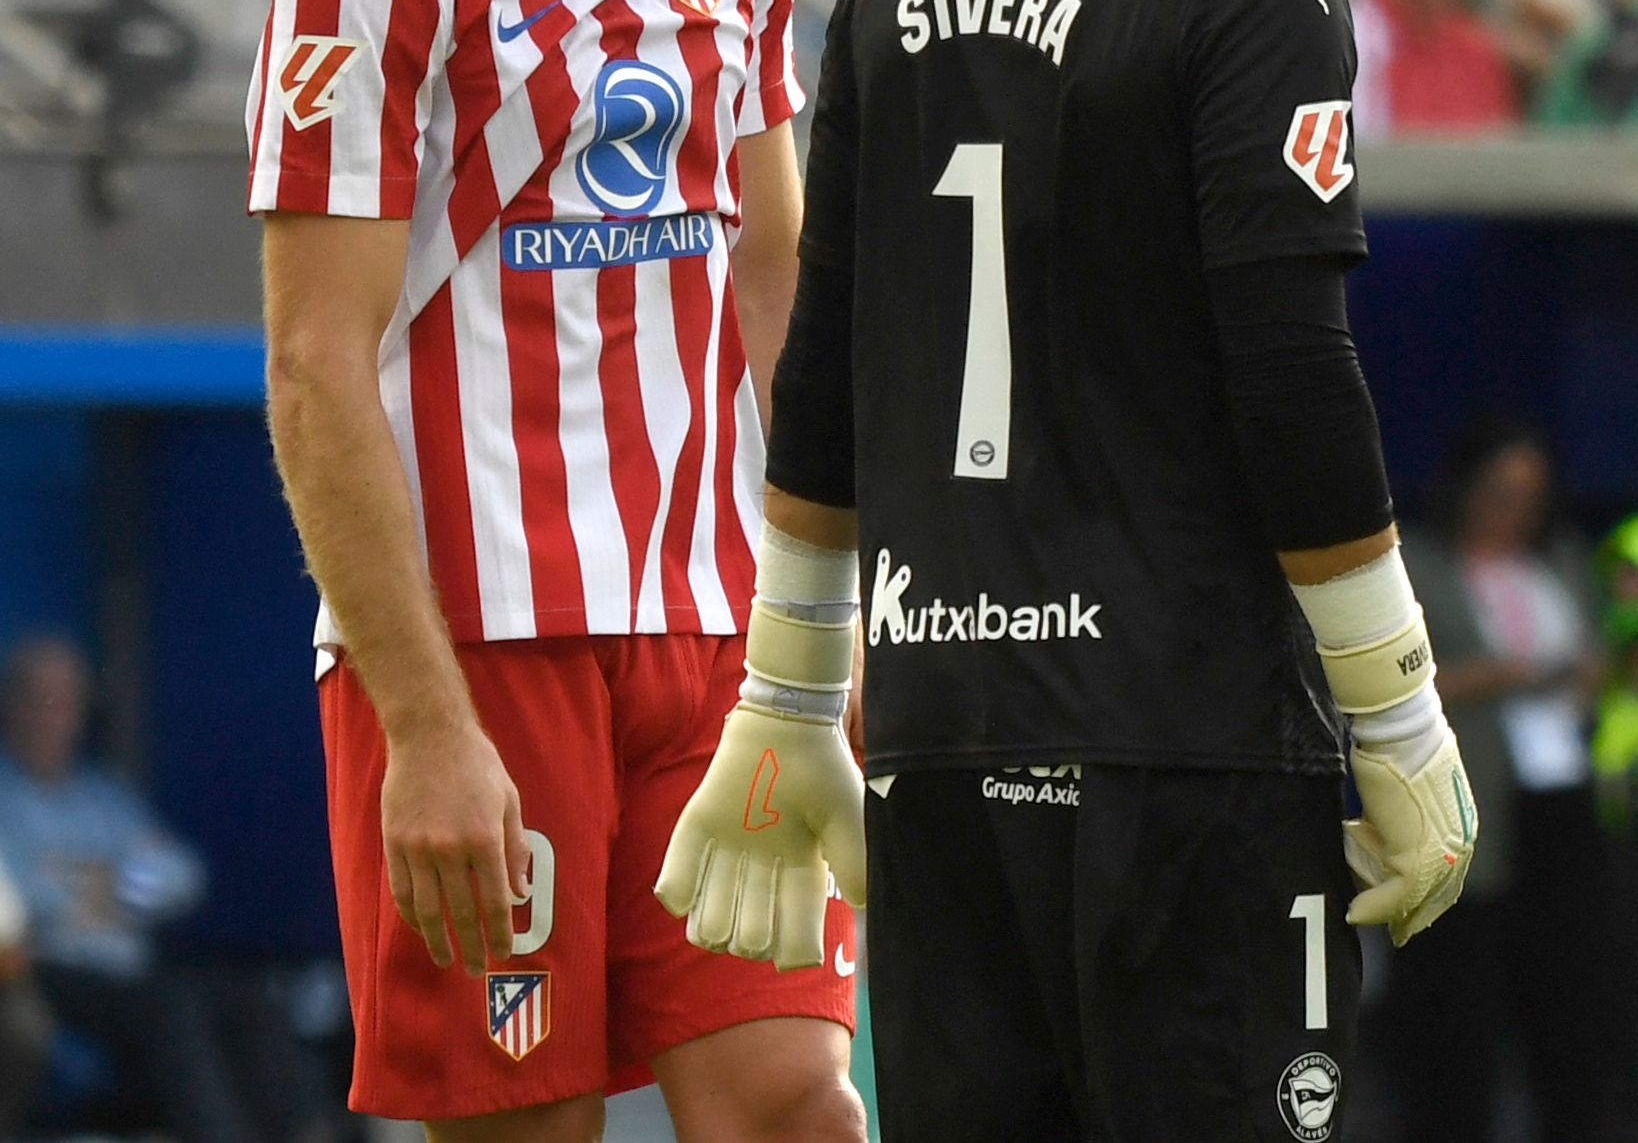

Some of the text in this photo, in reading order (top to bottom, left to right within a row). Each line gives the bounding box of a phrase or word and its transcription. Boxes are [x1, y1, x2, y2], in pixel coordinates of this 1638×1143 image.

[514, 214, 710, 265] RIYADH AIR
[932, 143, 1012, 480] 1
[982, 776, 1035, 805] Grupo
[1288, 894, 1328, 1030] 1
[1291, 1056, 1337, 1077] DEPORTIVO
